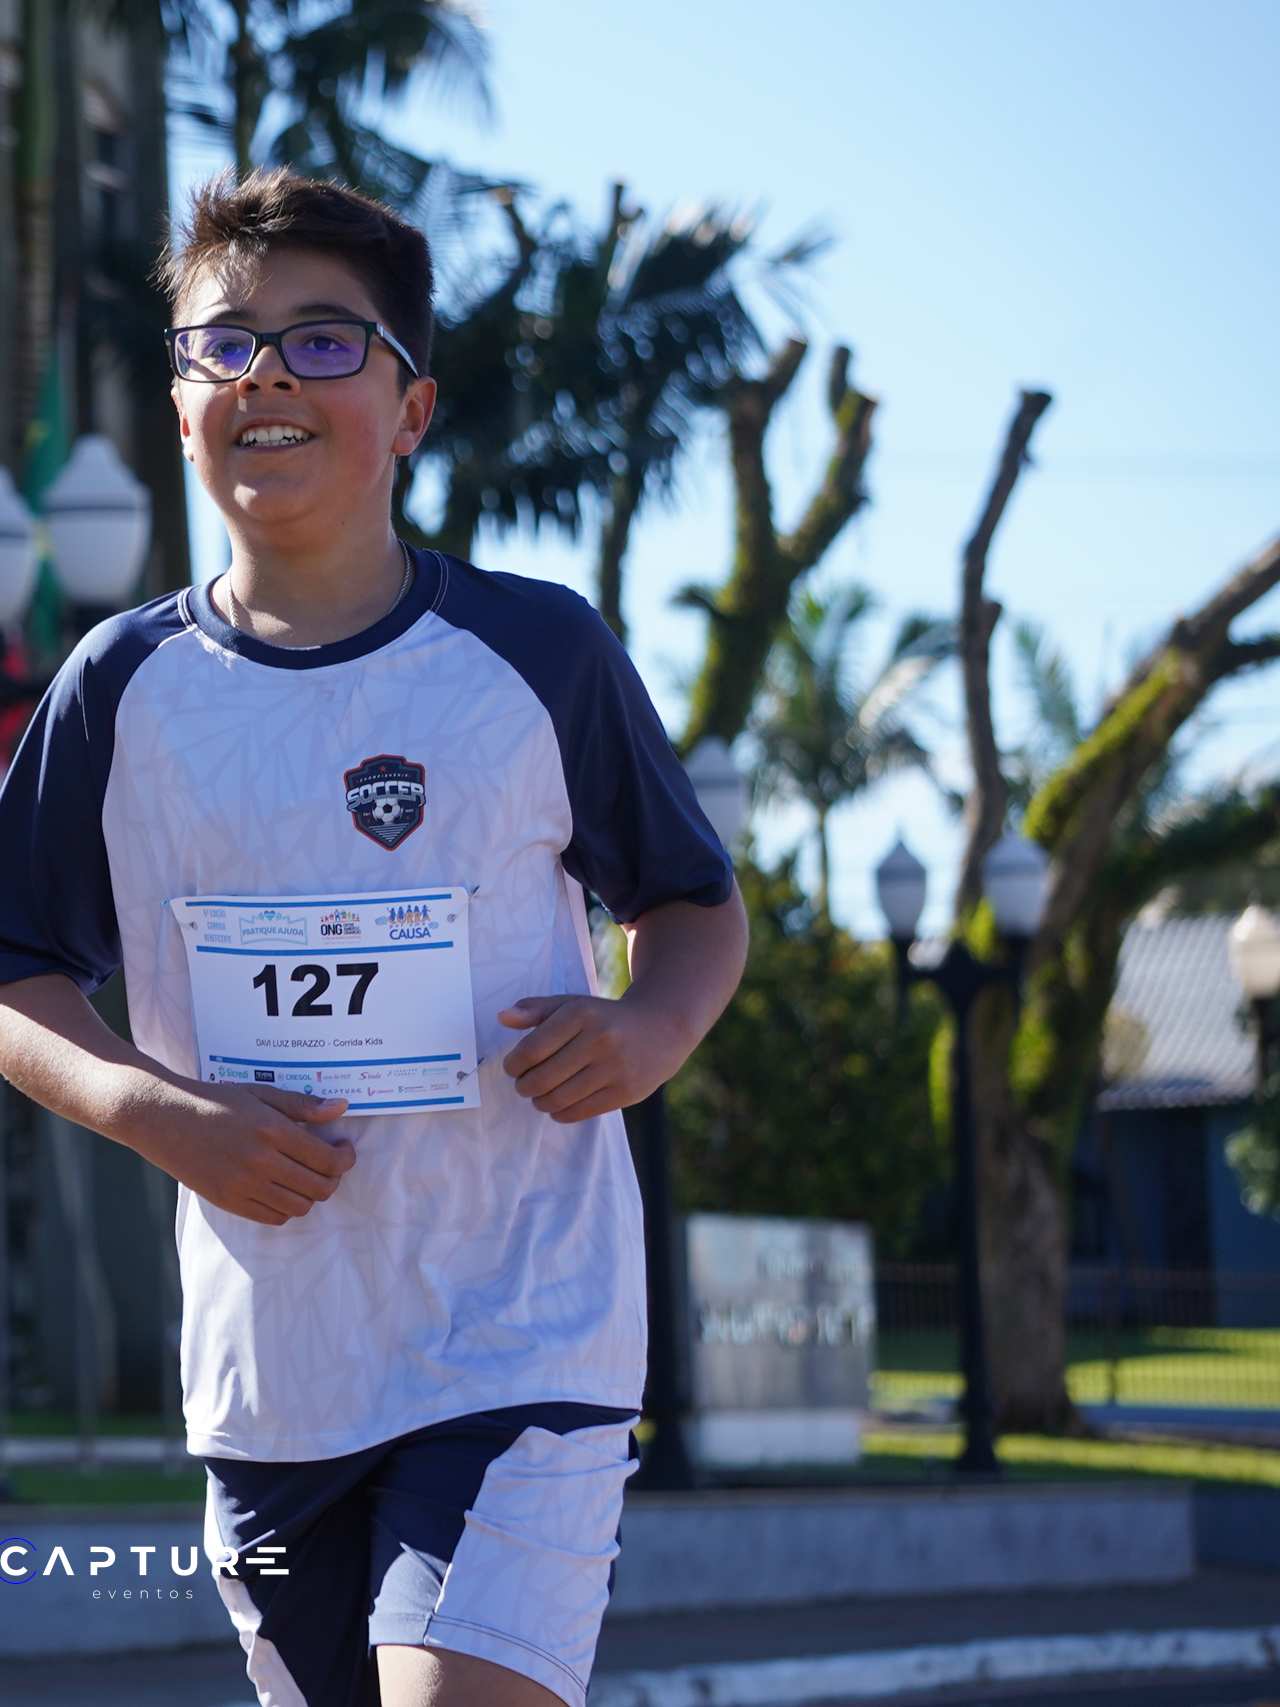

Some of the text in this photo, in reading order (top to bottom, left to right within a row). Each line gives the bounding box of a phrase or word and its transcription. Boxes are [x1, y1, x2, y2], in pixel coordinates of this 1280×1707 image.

[347, 781, 426, 812] SOCCER
[210, 908, 226, 918] EDIÇÃO
[207, 921, 226, 931] CORRIDA
[242, 926, 304, 937] PRATIQUE AJUDA
[320, 923, 343, 936] ONG
[204, 933, 232, 944] BENEFICENTE
[389, 927, 431, 940] CAUSA
[252, 962, 379, 1017] 127
[256, 1039, 271, 1047] DAVI
[273, 1040, 289, 1048] LUIZ
[291, 1039, 325, 1048] BRAZZO
[333, 1039, 363, 1047] Corrida
[365, 1038, 383, 1046] Kids
[226, 1069, 248, 1079] Sicredi
[322, 1088, 362, 1096] CAPTURE
